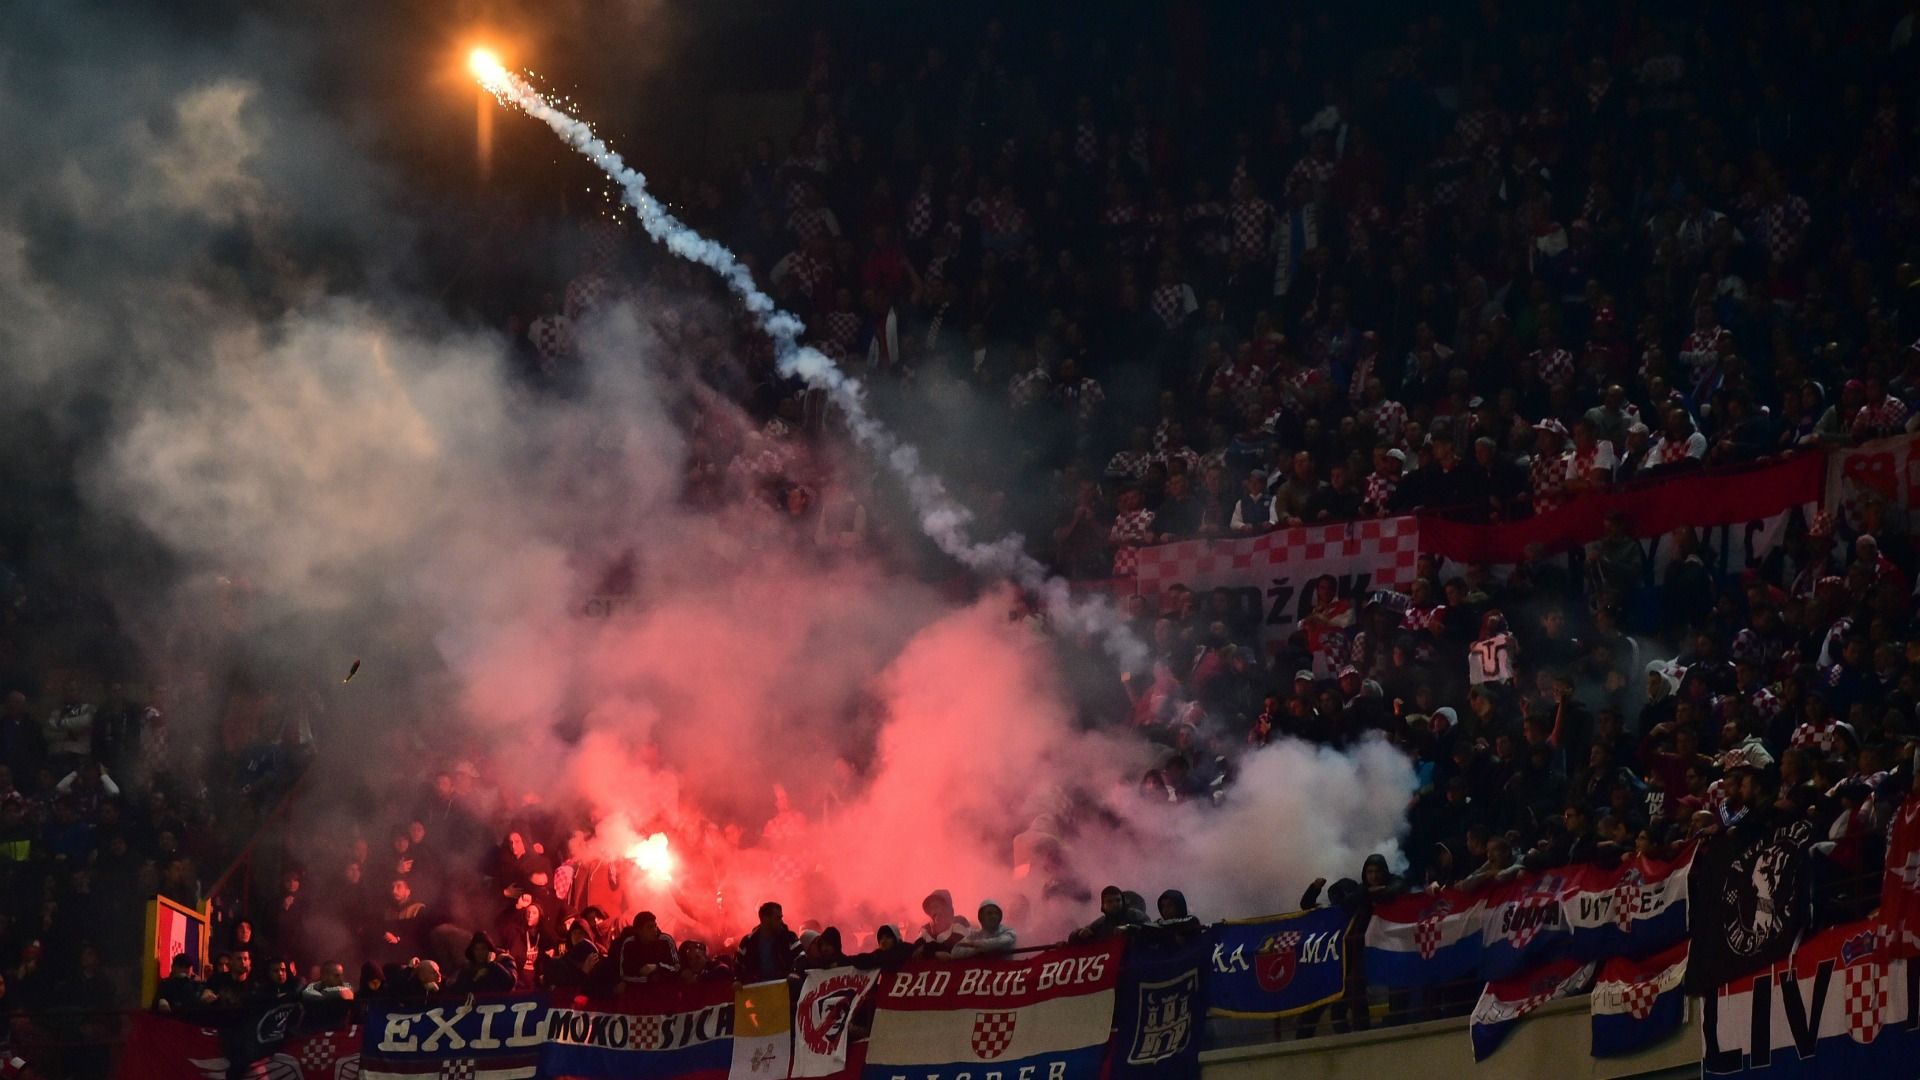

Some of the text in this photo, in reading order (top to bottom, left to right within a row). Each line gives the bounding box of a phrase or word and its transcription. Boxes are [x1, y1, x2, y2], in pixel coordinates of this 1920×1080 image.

[888, 952, 1111, 999] BAD BLUE BOYS
[377, 1001, 547, 1053] EXIL
[547, 1010, 629, 1048] MOKO
